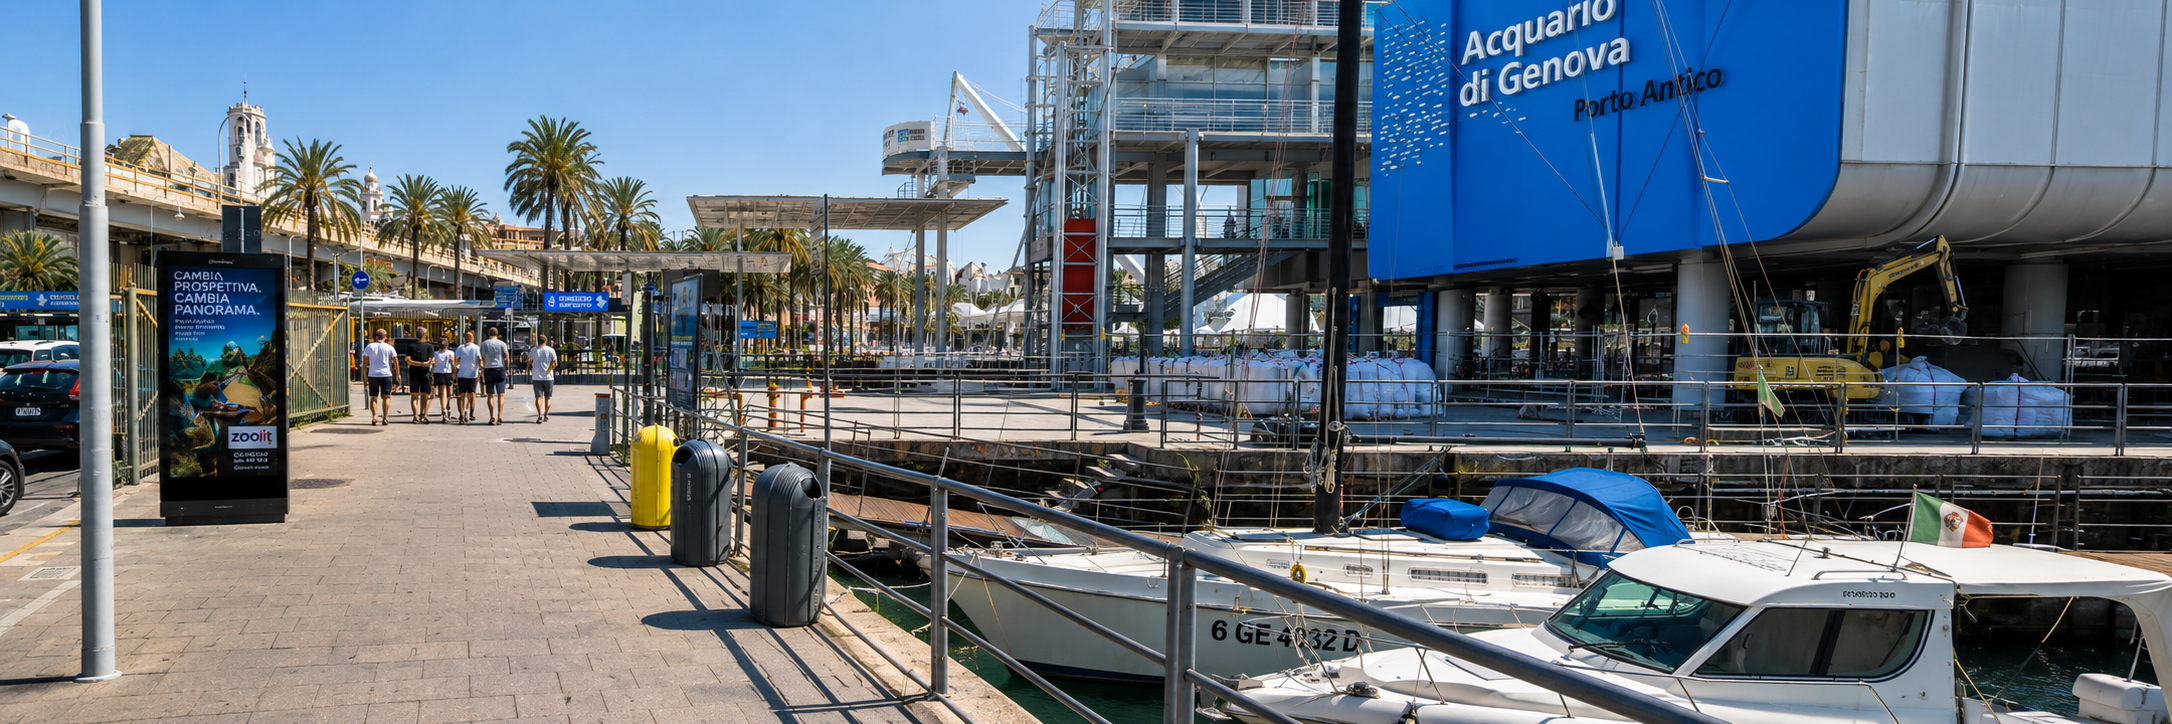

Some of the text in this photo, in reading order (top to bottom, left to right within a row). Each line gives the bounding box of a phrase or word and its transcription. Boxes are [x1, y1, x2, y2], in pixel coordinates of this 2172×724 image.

[1461, 0, 1617, 66] Acquario
[1459, 37, 1631, 107] di Genova
[1574, 67, 1722, 122] Porto Antico
[174, 270, 224, 281] CAMBIA
[174, 281, 262, 293] PROSPETTIVA.
[174, 293, 230, 304] CAMBIA
[174, 304, 260, 316] PANORAMA.
[1211, 619, 1228, 641] 6
[1235, 621, 1271, 646] GE
[1342, 629, 1362, 652] D
